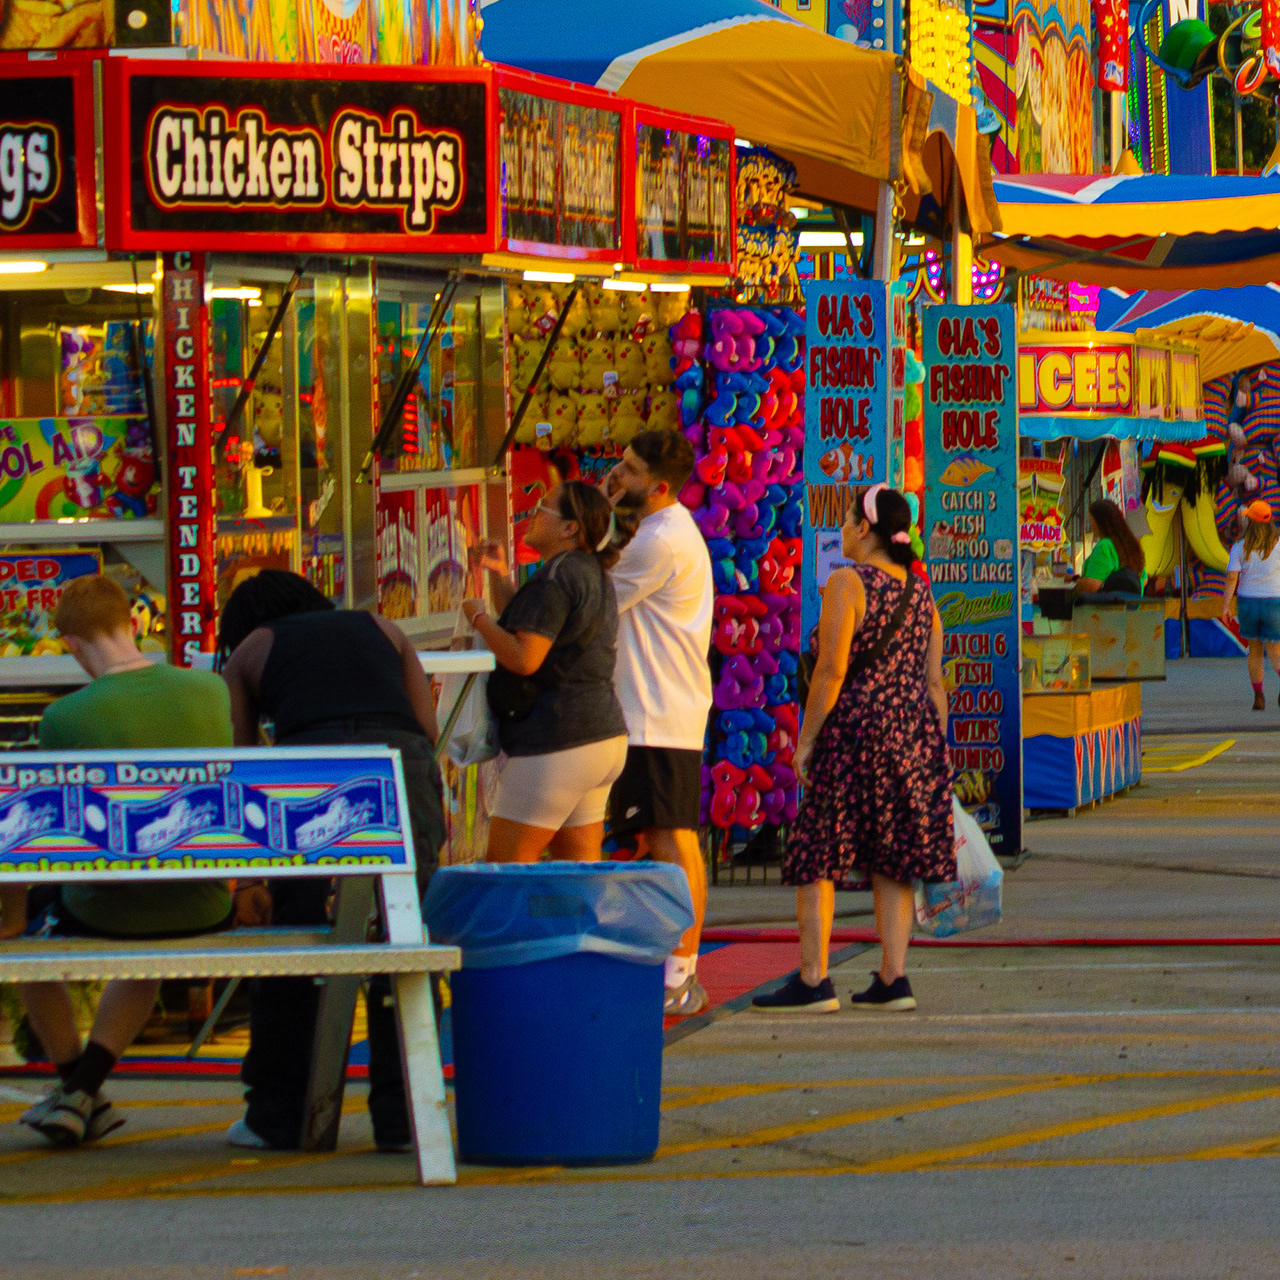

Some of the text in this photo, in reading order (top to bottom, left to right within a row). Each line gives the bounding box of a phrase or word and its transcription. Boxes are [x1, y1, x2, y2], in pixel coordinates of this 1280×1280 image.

[155, 116, 320, 202] Chicken
[336, 119, 458, 225] Strips
[816, 292, 875, 339] GIA'S
[937, 315, 1001, 358] GIA'S
[809, 344, 882, 390] FISHIN'
[928, 362, 1010, 404] FISHIN'
[1018, 351, 1131, 410] ICEES
[819, 395, 872, 442] HOLE
[941, 408, 1000, 451] HOLE
[0, 442, 45, 481] OL
[171, 250, 203, 668] CHICKEN TENDERS
[940, 490, 997, 512] CATCH 3
[953, 514, 986, 536] FISH
[930, 562, 1014, 583] WINS LARGE
[942, 632, 1007, 658] CATCH 6
[953, 661, 994, 686] FISH
[952, 719, 1001, 744] WINS
